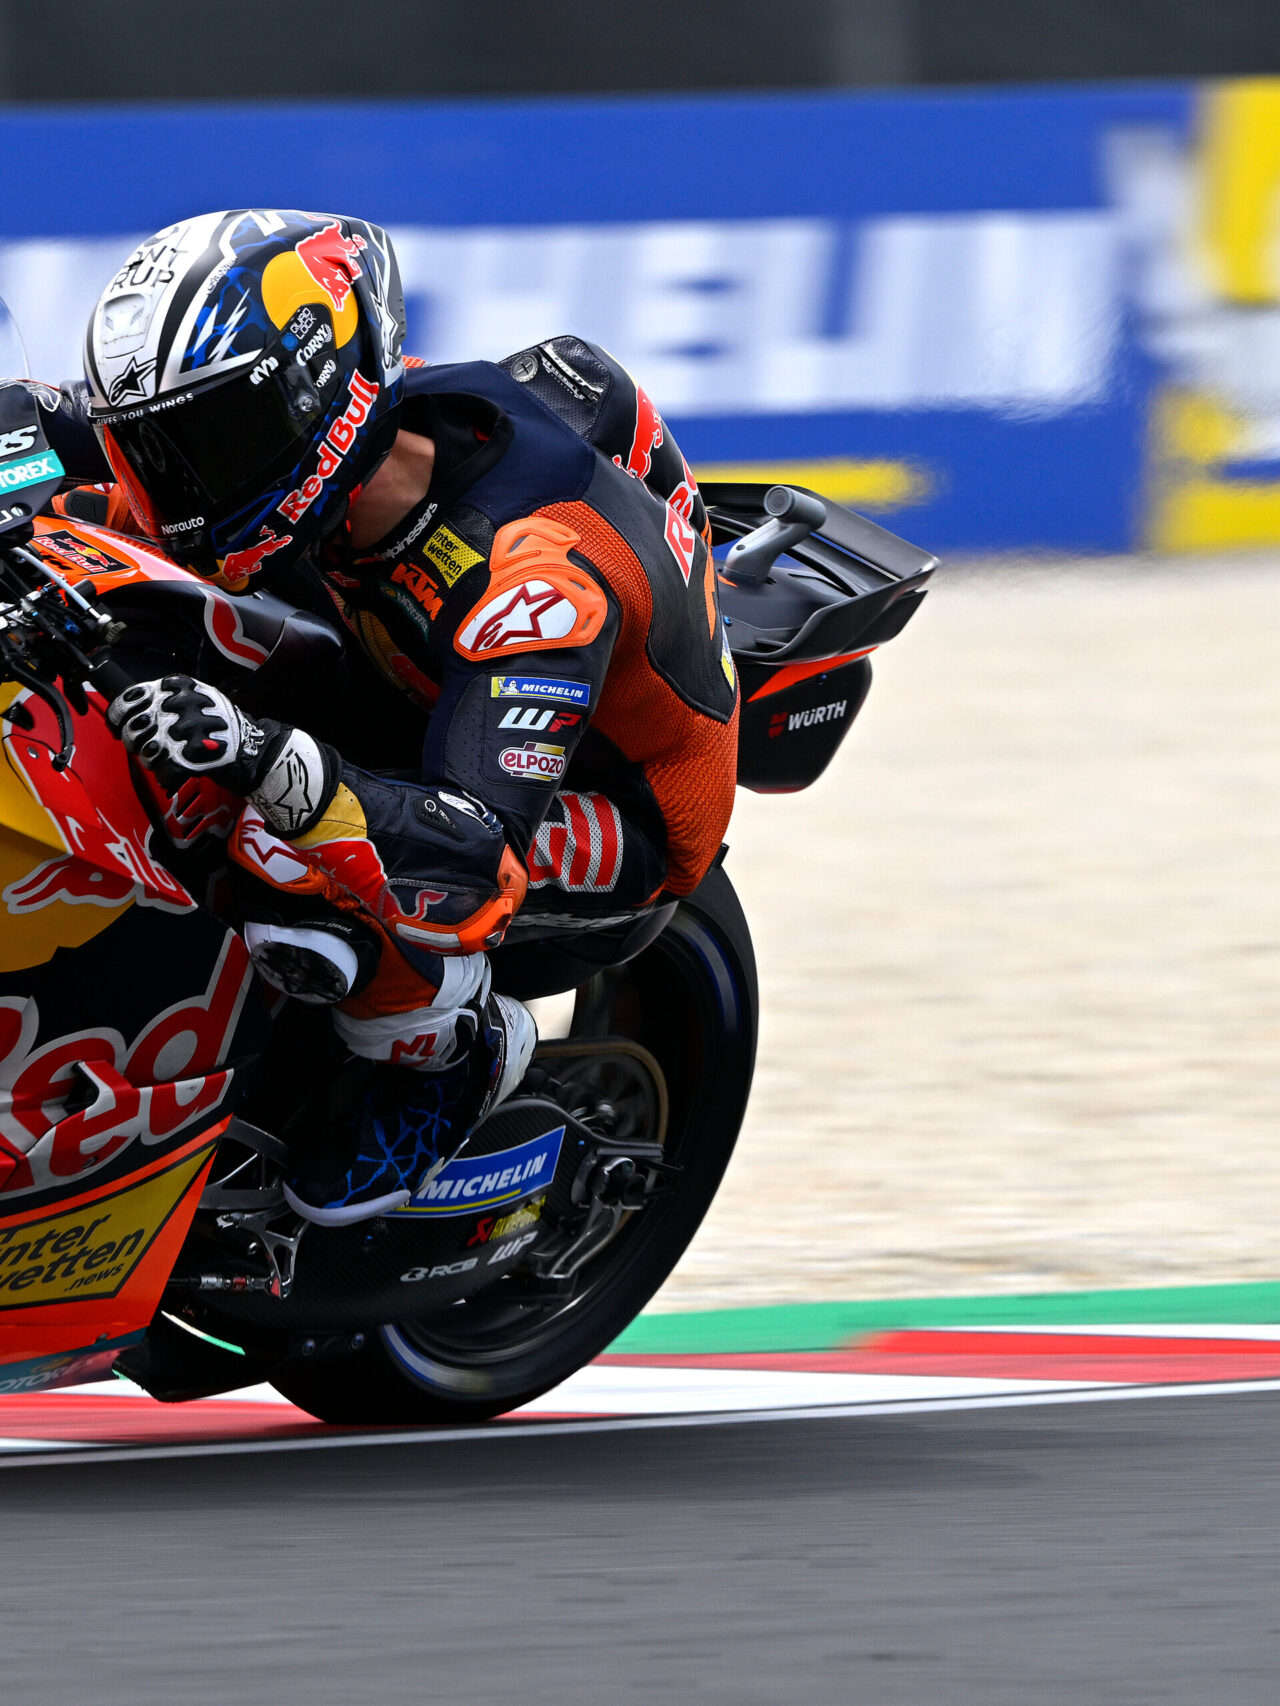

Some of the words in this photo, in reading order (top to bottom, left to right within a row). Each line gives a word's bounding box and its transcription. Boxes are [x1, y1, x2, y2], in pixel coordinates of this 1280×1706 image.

[290, 307, 311, 334] QUAD
[295, 313, 317, 340] LOCK
[296, 324, 331, 367] CORNY
[314, 359, 334, 388] ORNY
[122, 409, 144, 420] YOU
[148, 392, 194, 413] WINGS
[277, 441, 343, 524] Red
[326, 368, 380, 455] Bull
[161, 516, 205, 535] Norauto
[380, 502, 438, 558] alpinestars
[32, 536, 77, 556] Red
[64, 552, 108, 573] Bull
[432, 530, 459, 554] inter
[427, 541, 463, 577] wetten
[391, 563, 444, 621] KTM
[521, 683, 584, 698] MICHELIN
[498, 707, 582, 733] WP
[788, 700, 847, 731] WÜRTH
[416, 1152, 548, 1200] MICHELIN
[64, 1263, 124, 1292] .news
[428, 1258, 479, 1278] RCB
